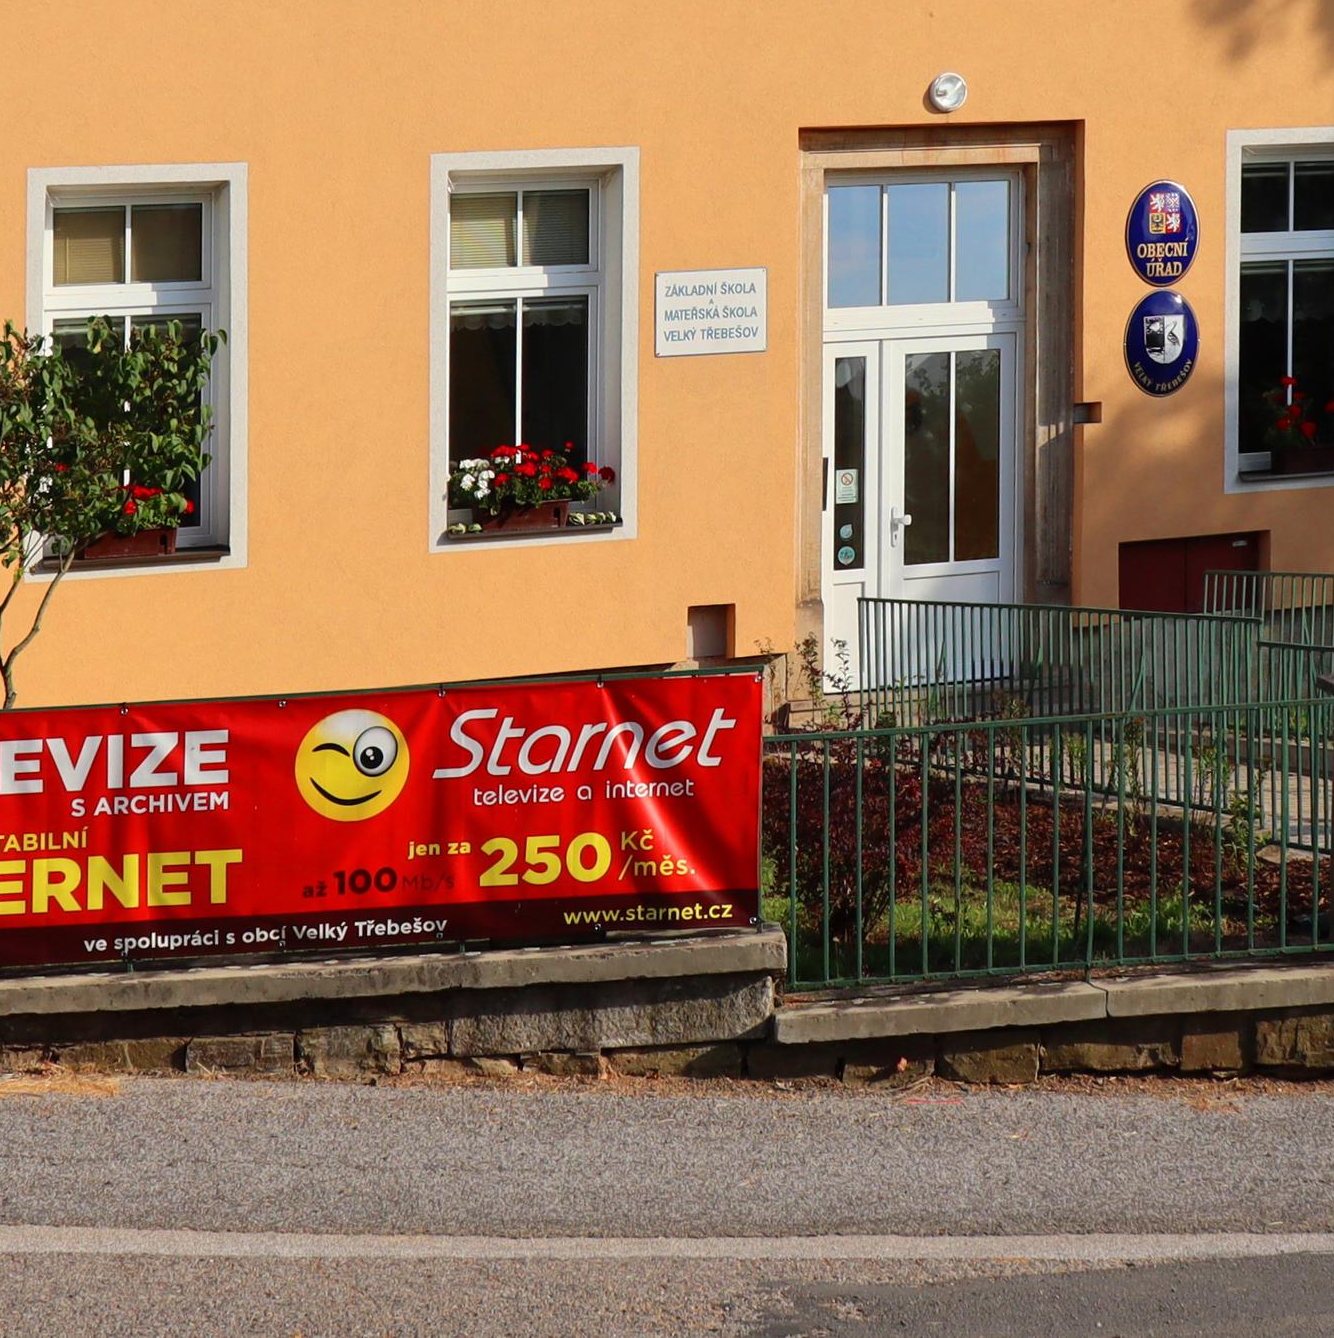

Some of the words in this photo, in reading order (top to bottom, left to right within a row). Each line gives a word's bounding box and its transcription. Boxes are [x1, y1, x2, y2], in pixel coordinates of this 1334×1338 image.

[1137, 238, 1188, 258] OBECNÍ
[1145, 257, 1183, 277] ÚŘAD
[665, 282, 717, 297] ZÁKLADNÍ
[720, 282, 756, 295] ŠKOLA
[664, 306, 720, 322] MATEŘSKÁ
[722, 305, 758, 319] ŠKOLA
[664, 326, 697, 342] VELKÝ
[700, 324, 759, 340] TŘEBEŠOV
[432, 708, 736, 780] Starnet
[70, 798, 86, 818] S
[93, 791, 230, 817] ARCHIVEM
[474, 786, 565, 807] televize
[577, 786, 592, 801] a
[605, 778, 695, 800] internet
[408, 840, 442, 861] jen
[447, 842, 471, 856] za
[479, 832, 612, 888] 250
[621, 828, 654, 853] Kč
[618, 855, 697, 882] /měs.
[302, 880, 327, 899] až
[333, 866, 397, 894] 100
[401, 874, 456, 892] Mb/s
[564, 902, 733, 926] www.starnet.cz
[83, 938, 107, 952] ve
[113, 928, 220, 955] spolupráci
[225, 933, 236, 946] s
[243, 926, 287, 944] obcí
[293, 922, 348, 942] Velký
[355, 917, 447, 939] Třebešov
